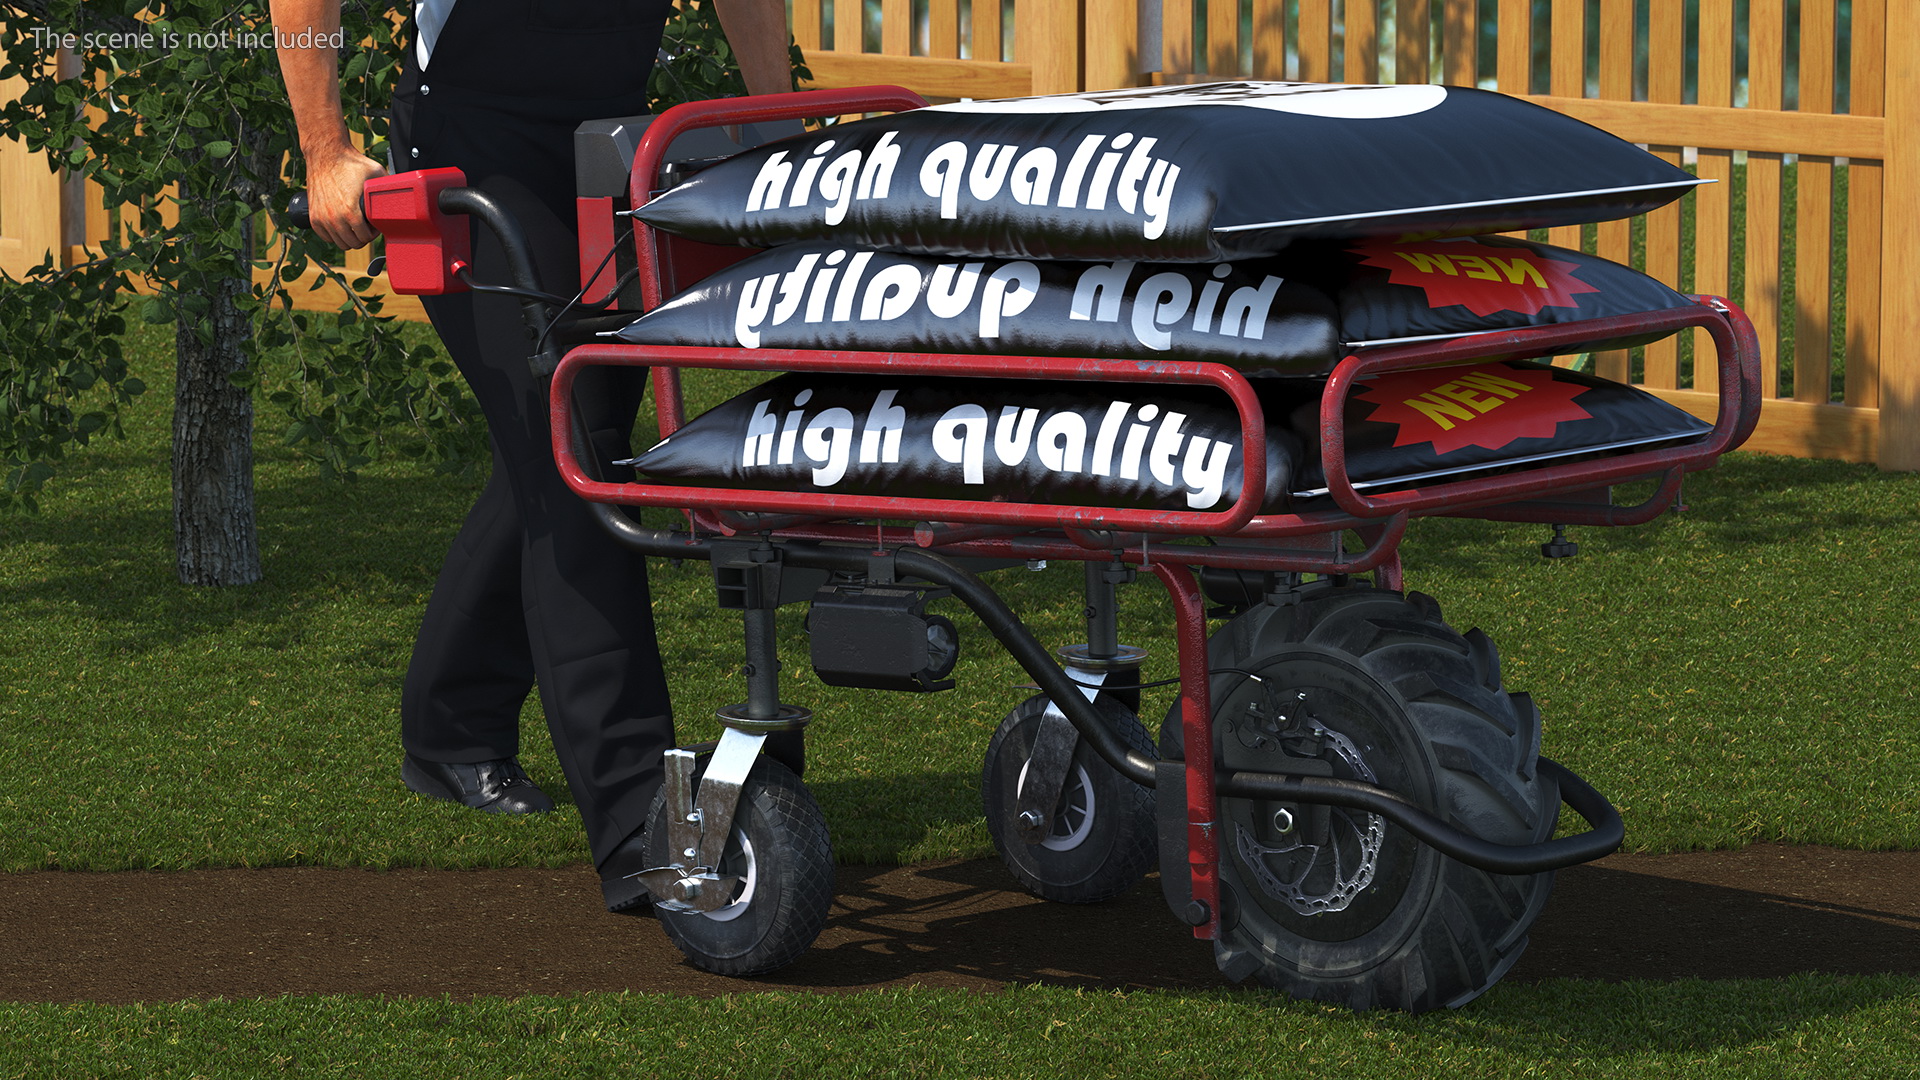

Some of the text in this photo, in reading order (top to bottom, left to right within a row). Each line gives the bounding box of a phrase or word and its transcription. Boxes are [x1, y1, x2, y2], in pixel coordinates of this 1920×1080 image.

[745, 130, 1181, 240] high quality
[742, 388, 1234, 510] high quality
[1402, 371, 1534, 431] NEW
